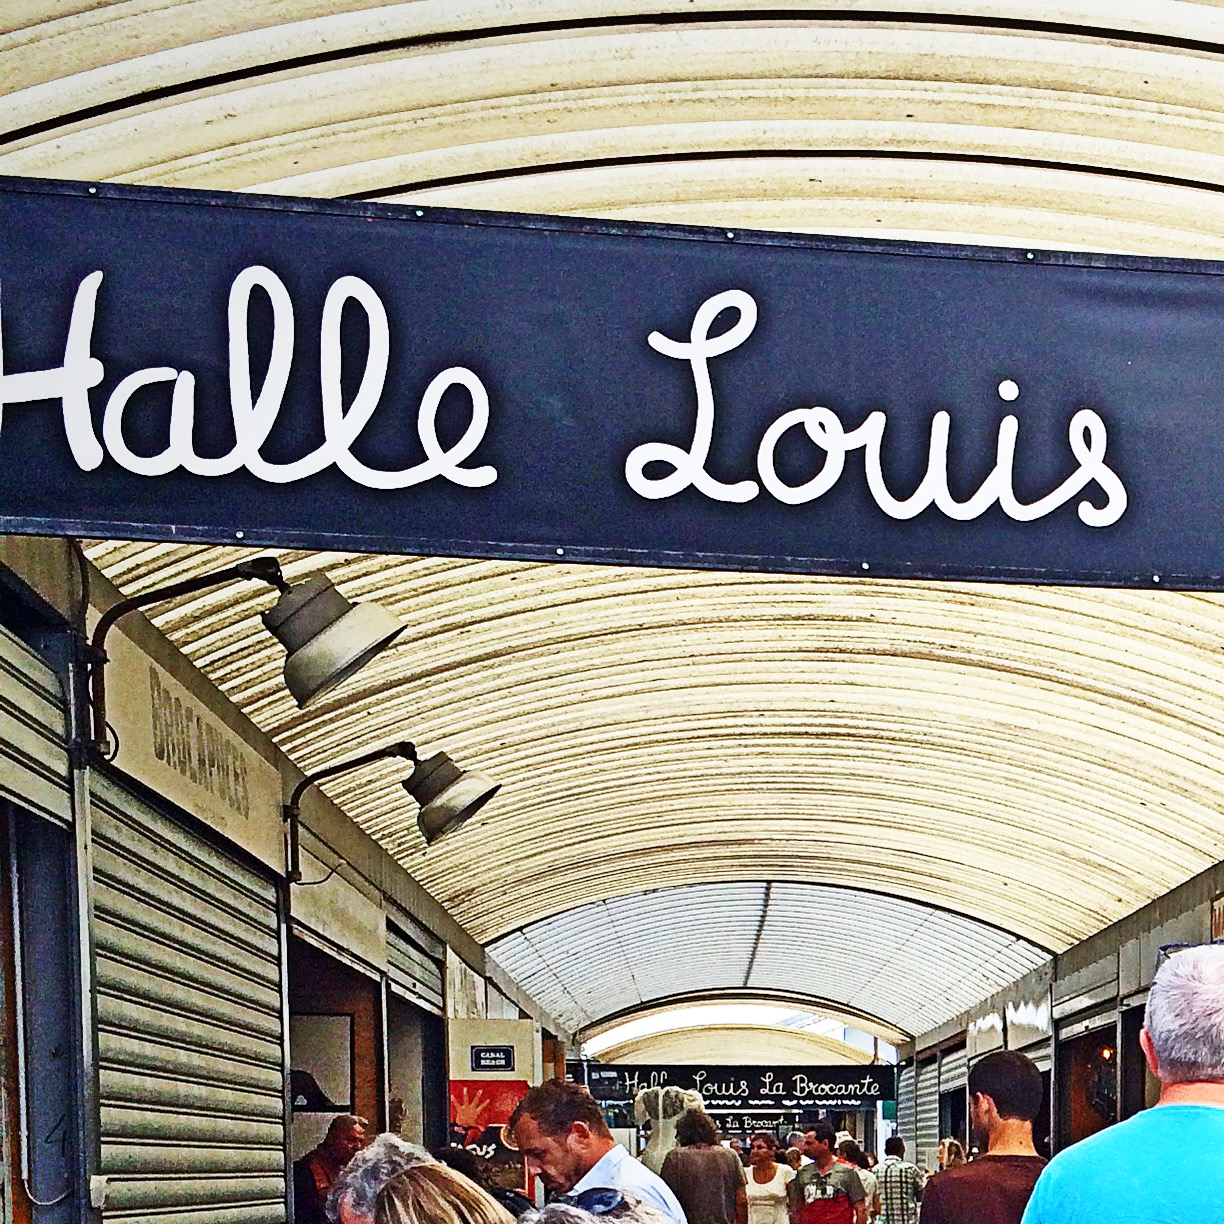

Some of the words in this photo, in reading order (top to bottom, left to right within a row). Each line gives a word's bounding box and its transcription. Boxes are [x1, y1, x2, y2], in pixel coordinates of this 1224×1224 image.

[0, 266, 497, 489] Halle
[626, 290, 1126, 526] Louis
[692, 1070, 749, 1097] Louis
[760, 1072, 787, 1095] La
[792, 1074, 880, 1097] Brocante
[742, 1115, 787, 1129] Brocant
